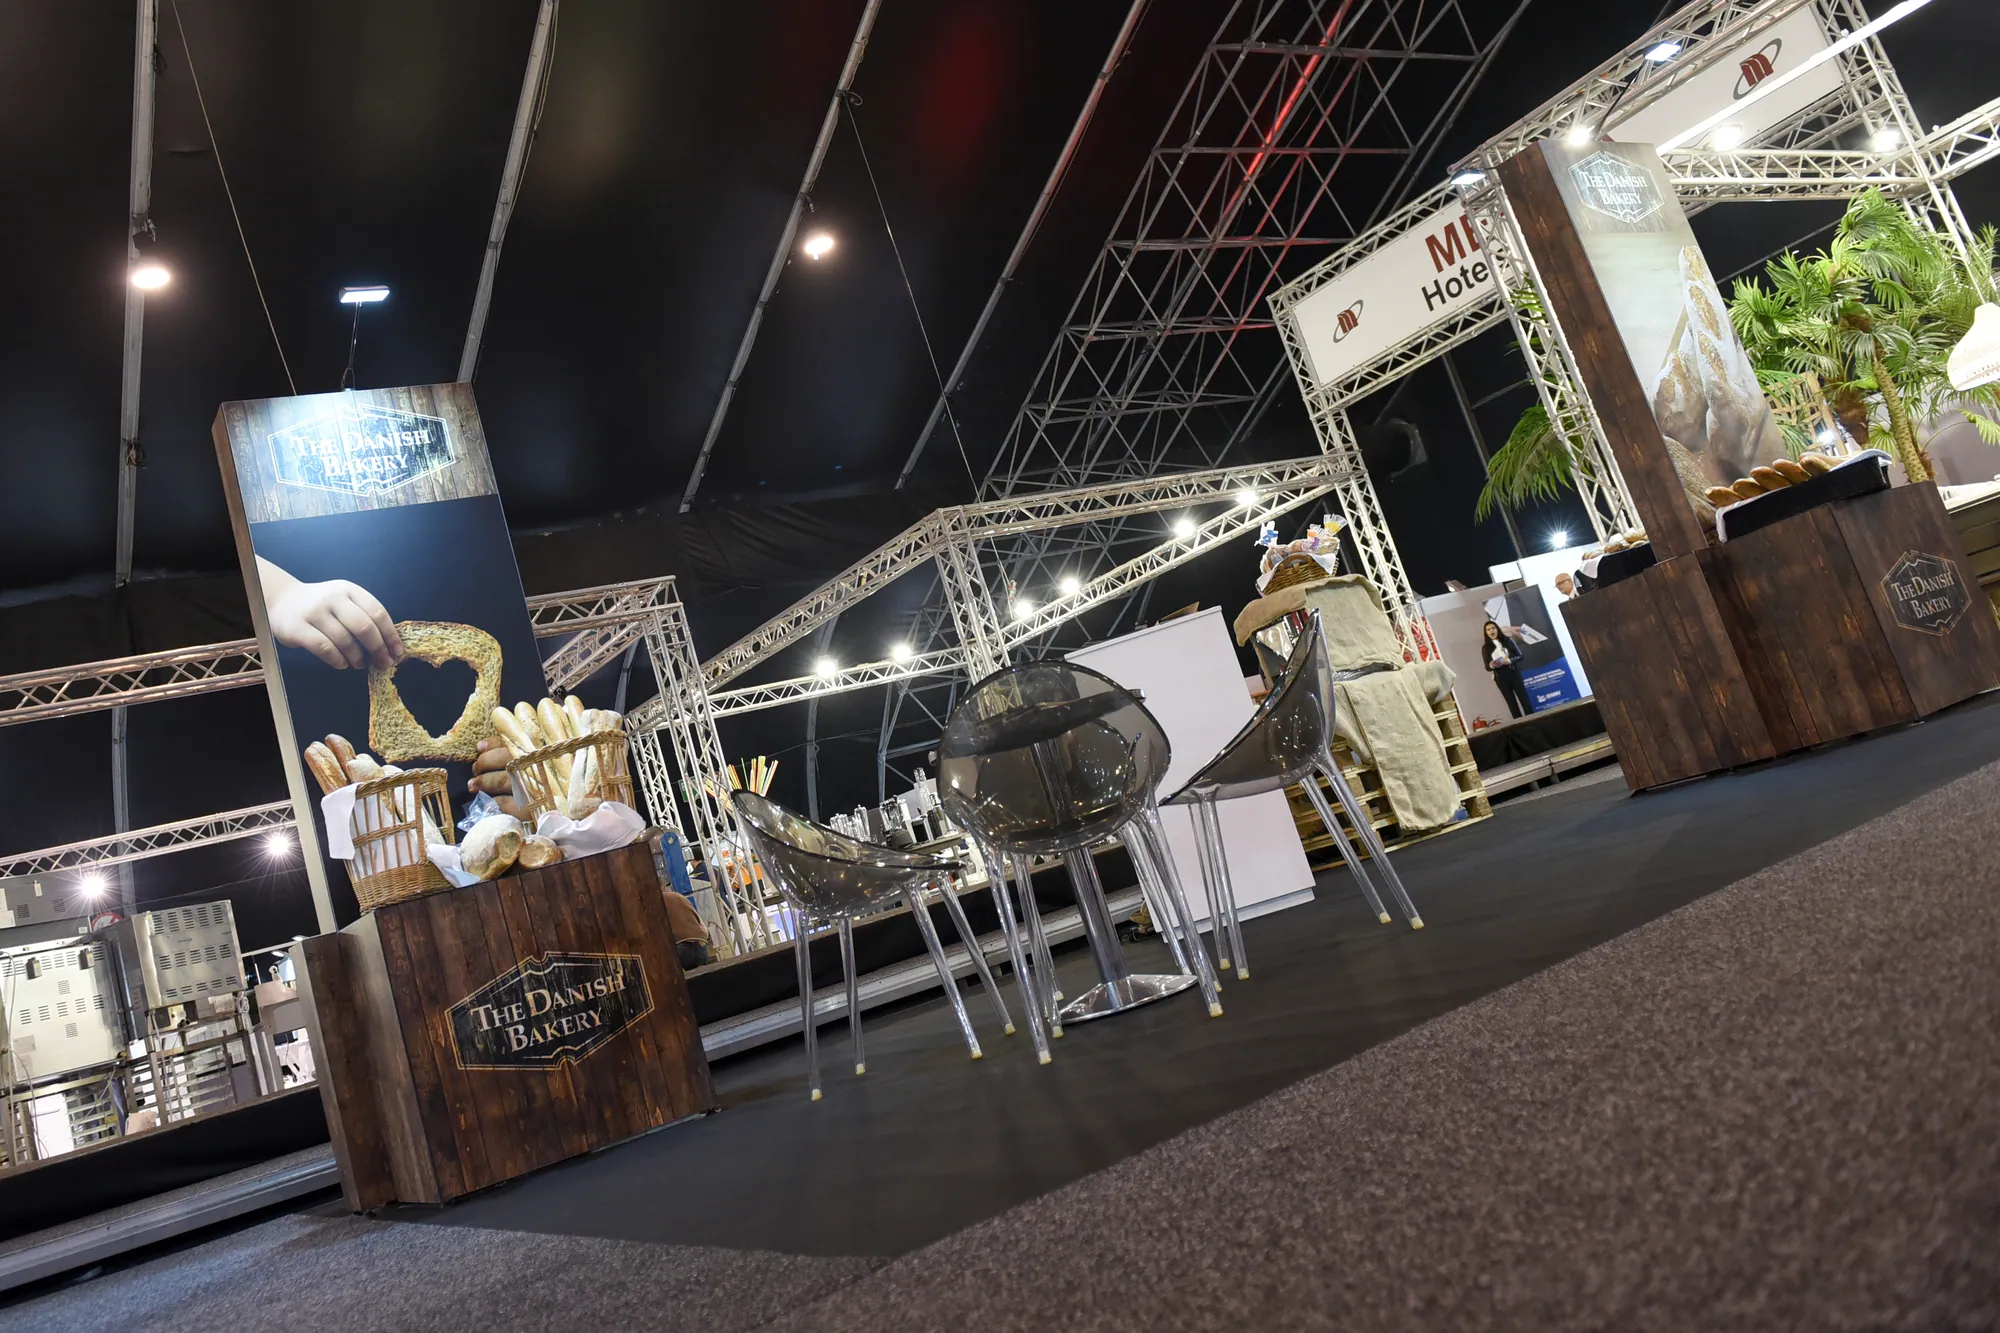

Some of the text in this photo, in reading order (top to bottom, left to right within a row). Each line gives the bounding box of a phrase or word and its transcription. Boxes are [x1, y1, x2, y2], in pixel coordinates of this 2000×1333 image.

[1579, 171, 1649, 188] THE DANISH
[1597, 188, 1642, 205] BAKERY
[291, 429, 432, 457] THE DANISH
[319, 453, 409, 478] BAKERY
[1890, 572, 1955, 602] THE DANISH
[1910, 595, 1952, 619] BAKERY
[470, 973, 627, 1032] THE DANISH
[505, 1007, 603, 1053] BAKERY
